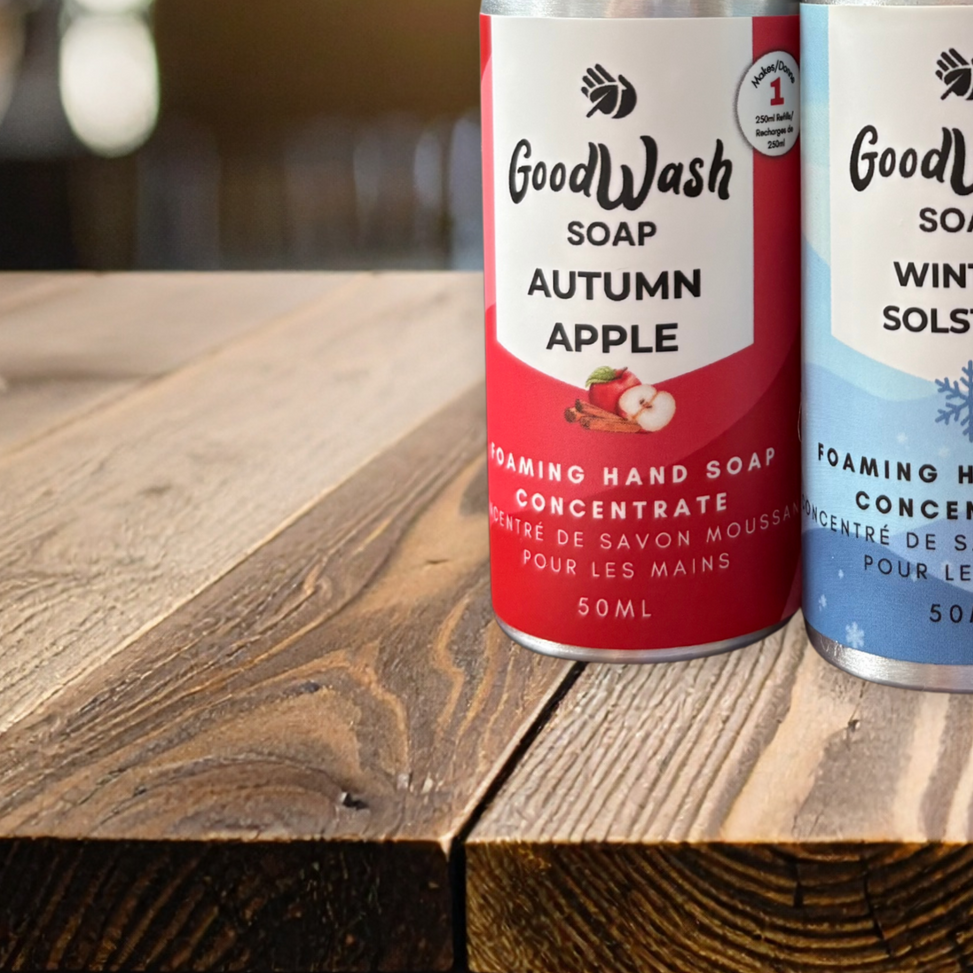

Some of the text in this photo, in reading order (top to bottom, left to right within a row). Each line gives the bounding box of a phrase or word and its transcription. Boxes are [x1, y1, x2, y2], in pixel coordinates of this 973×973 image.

[770, 77, 784, 106] 1
[755, 114, 775, 124] 250ml
[767, 138, 785, 150] 250ml
[508, 135, 733, 211] GoodWash
[566, 221, 657, 247] SOAP
[527, 268, 702, 302] AUTUMN
[546, 322, 679, 354] APPLE
[490, 442, 776, 486] FOAMING HAND SOAP
[817, 442, 938, 483] FOAMING
[515, 488, 728, 520] CONCENTRATE
[557, 529, 584, 548] DE
[600, 530, 690, 550] SAVON
[906, 532, 936, 551] DE
[523, 549, 730, 578] POUR LES MAINS
[864, 554, 928, 580] POUR
[578, 597, 652, 618] 50ML
